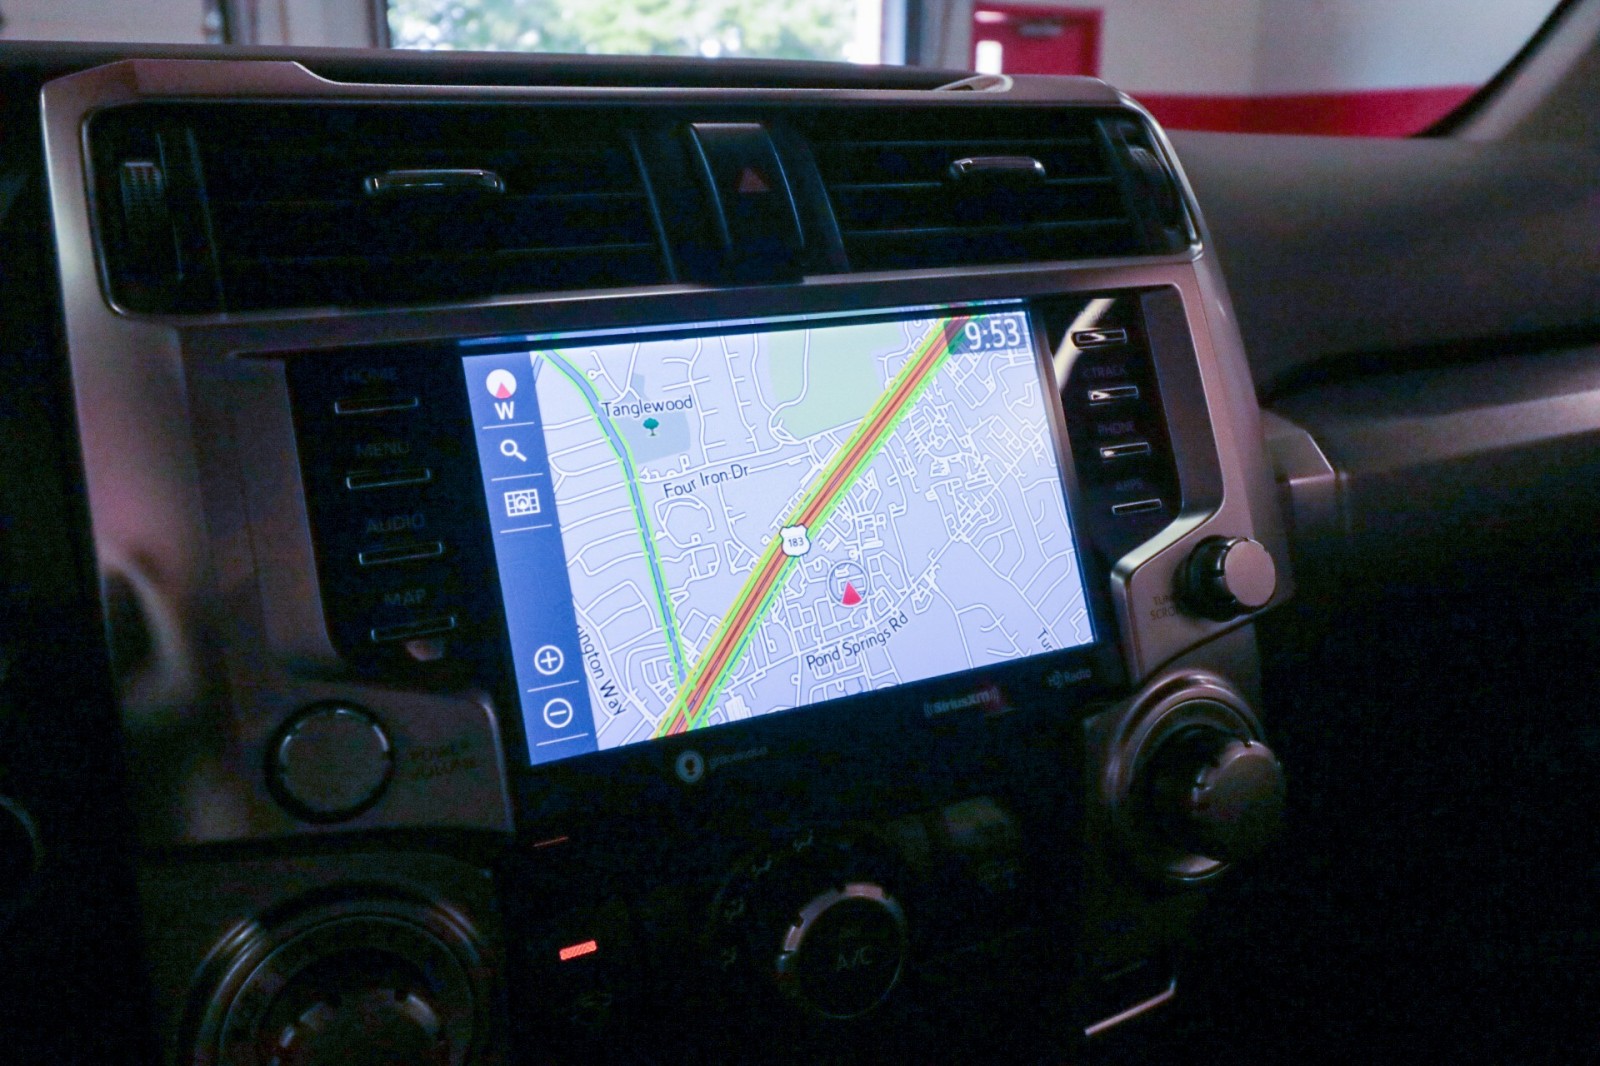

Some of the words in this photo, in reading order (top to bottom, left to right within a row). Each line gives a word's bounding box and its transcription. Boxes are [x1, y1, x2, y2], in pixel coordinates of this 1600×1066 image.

[964, 318, 1021, 350] 9:53
[495, 401, 515, 420] W
[602, 395, 694, 418] Tanglewood
[663, 480, 697, 498] Four
[699, 471, 729, 487] Iron
[730, 463, 749, 480] Dr
[366, 510, 426, 534] AUDIO
[788, 536, 804, 547] 183
[382, 587, 427, 607] MAP
[806, 645, 841, 670] Pond
[842, 628, 892, 657] Springs
[888, 610, 909, 633] Rd
[577, 624, 605, 680] ington
[600, 679, 627, 716] Way
